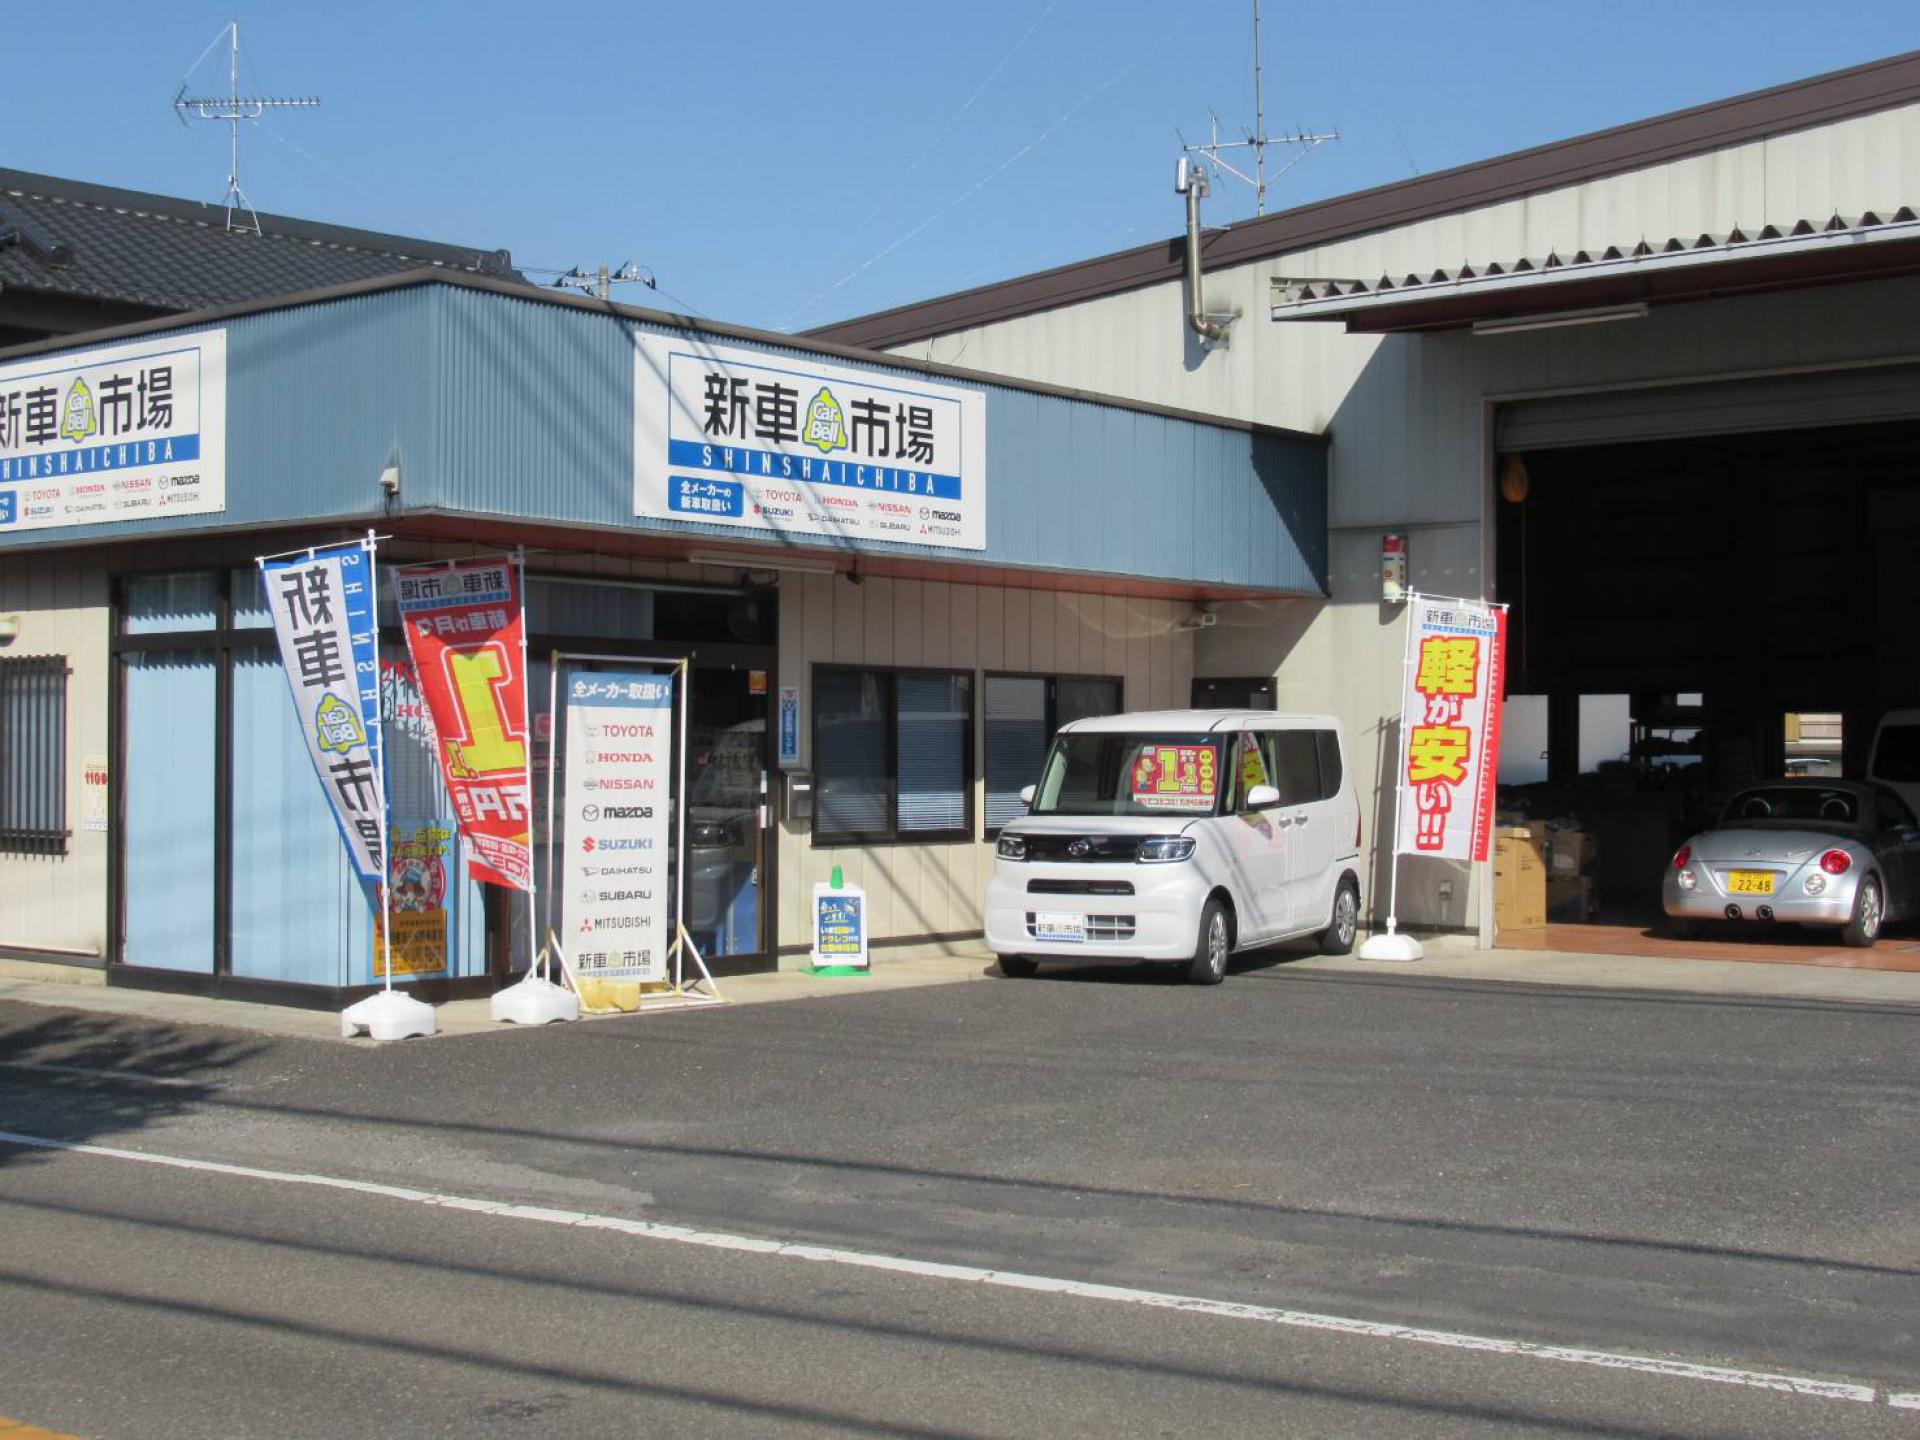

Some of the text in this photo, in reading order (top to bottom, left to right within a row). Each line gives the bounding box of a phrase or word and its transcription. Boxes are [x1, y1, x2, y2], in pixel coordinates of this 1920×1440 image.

[100, 366, 173, 436] 市場
[704, 373, 934, 465] 新車 市場
[813, 401, 839, 421] Car
[811, 420, 838, 443] Bell
[703, 445, 934, 495] SHINSHAICHIBA
[33, 488, 61, 501] TOYOTA
[76, 484, 105, 494] HONDA
[121, 478, 151, 489] NISSAN
[765, 489, 802, 502] TOYOTA
[822, 497, 859, 509] HONDA
[878, 503, 911, 515] NISSAN
[762, 506, 794, 517] SUZUKI
[820, 515, 860, 526] DAIHATSU
[879, 521, 911, 532] SUBARU
[1426, 610, 1453, 625] 新車
[572, 679, 670, 700] 全メーカー取扱い
[602, 724, 654, 738] TOYOTA
[597, 753, 653, 764] HONDA
[599, 778, 654, 790] NISSAN
[603, 805, 653, 820] mazda
[597, 838, 653, 851] SUZUKI
[601, 866, 652, 876] DAIHATSU
[1738, 879, 1771, 893] 22-48
[598, 890, 652, 901] SUBARU
[594, 915, 651, 930] MITSUBISHI
[578, 949, 651, 970] 新車 市場
